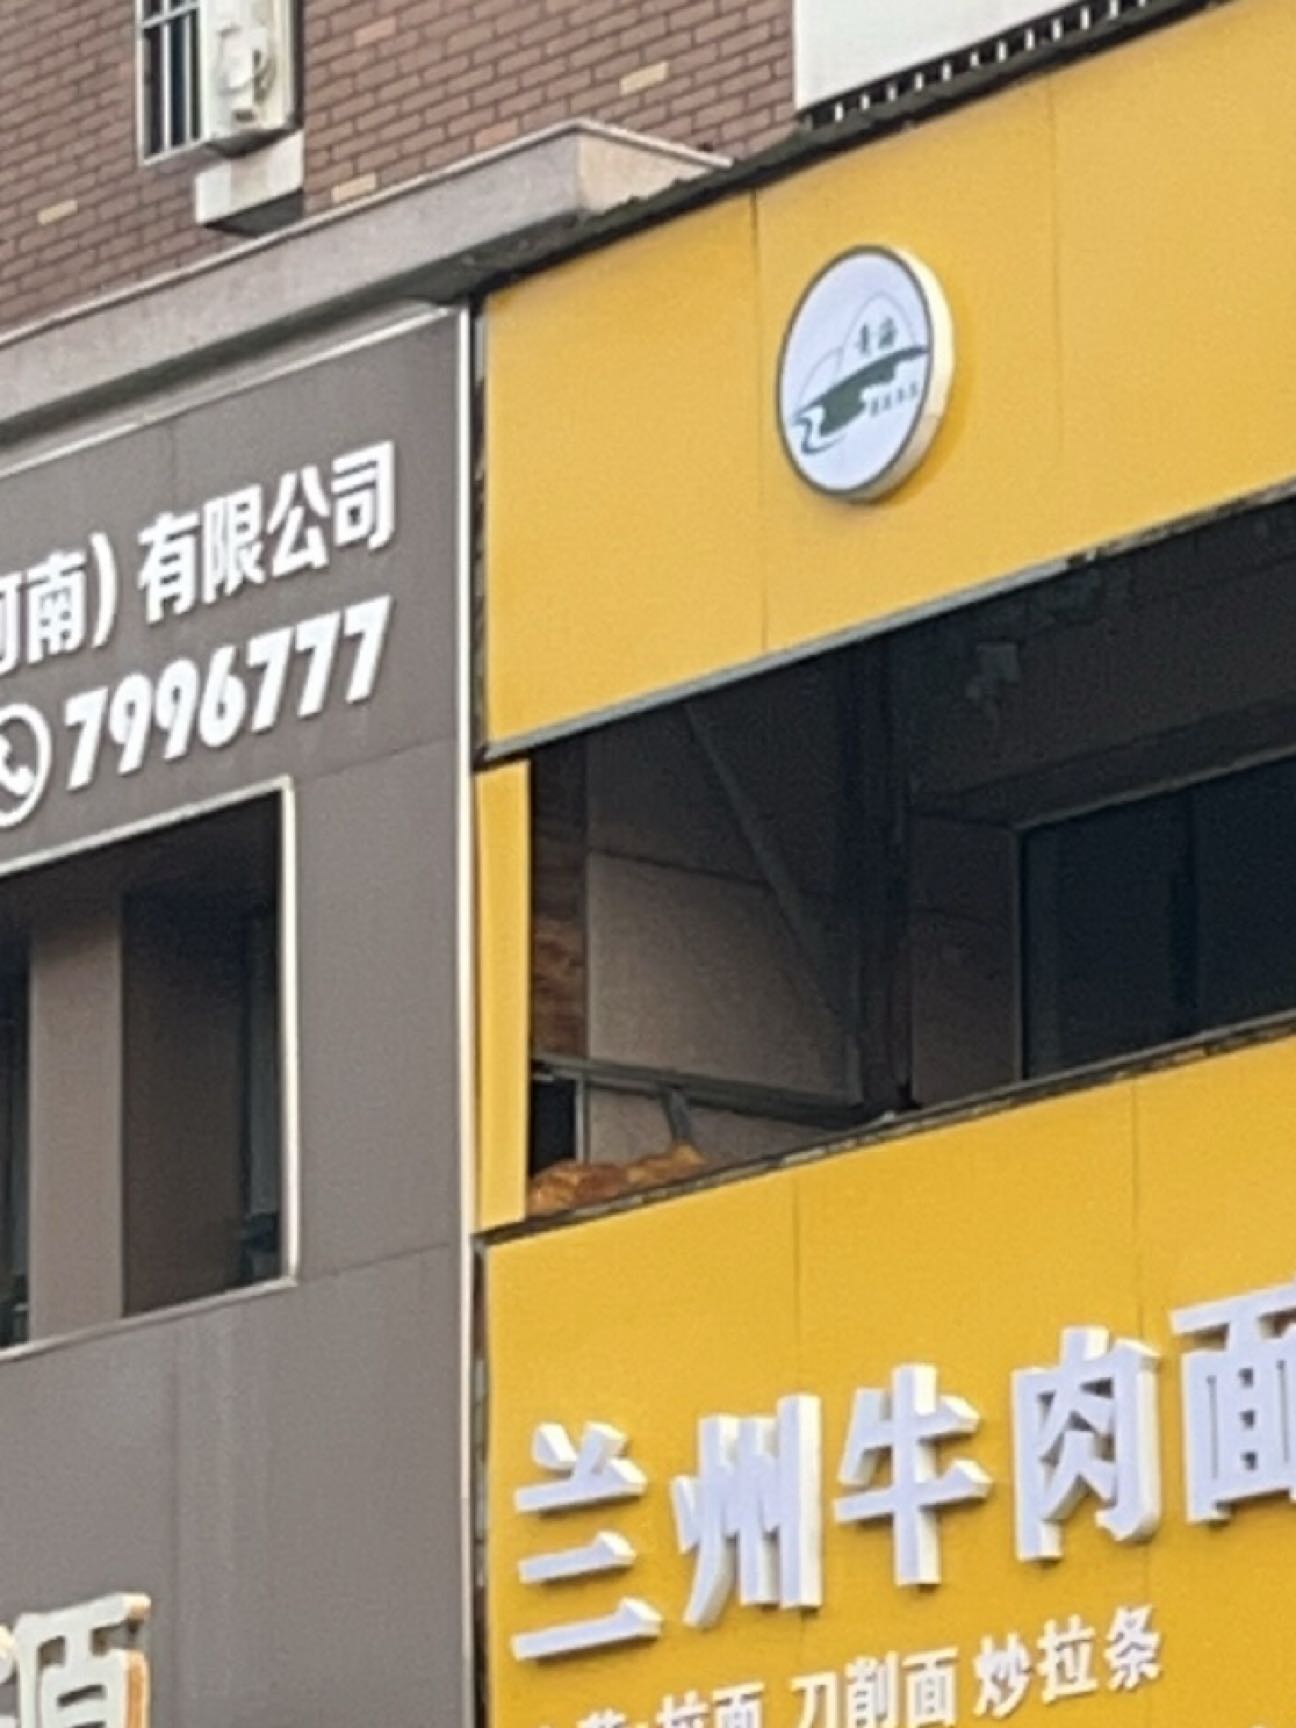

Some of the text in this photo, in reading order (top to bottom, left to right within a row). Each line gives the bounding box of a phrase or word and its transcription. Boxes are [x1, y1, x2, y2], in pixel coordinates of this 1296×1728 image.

[65, 595, 391, 791] 7996777
[974, 1603, 1162, 1718] 炒拉条
